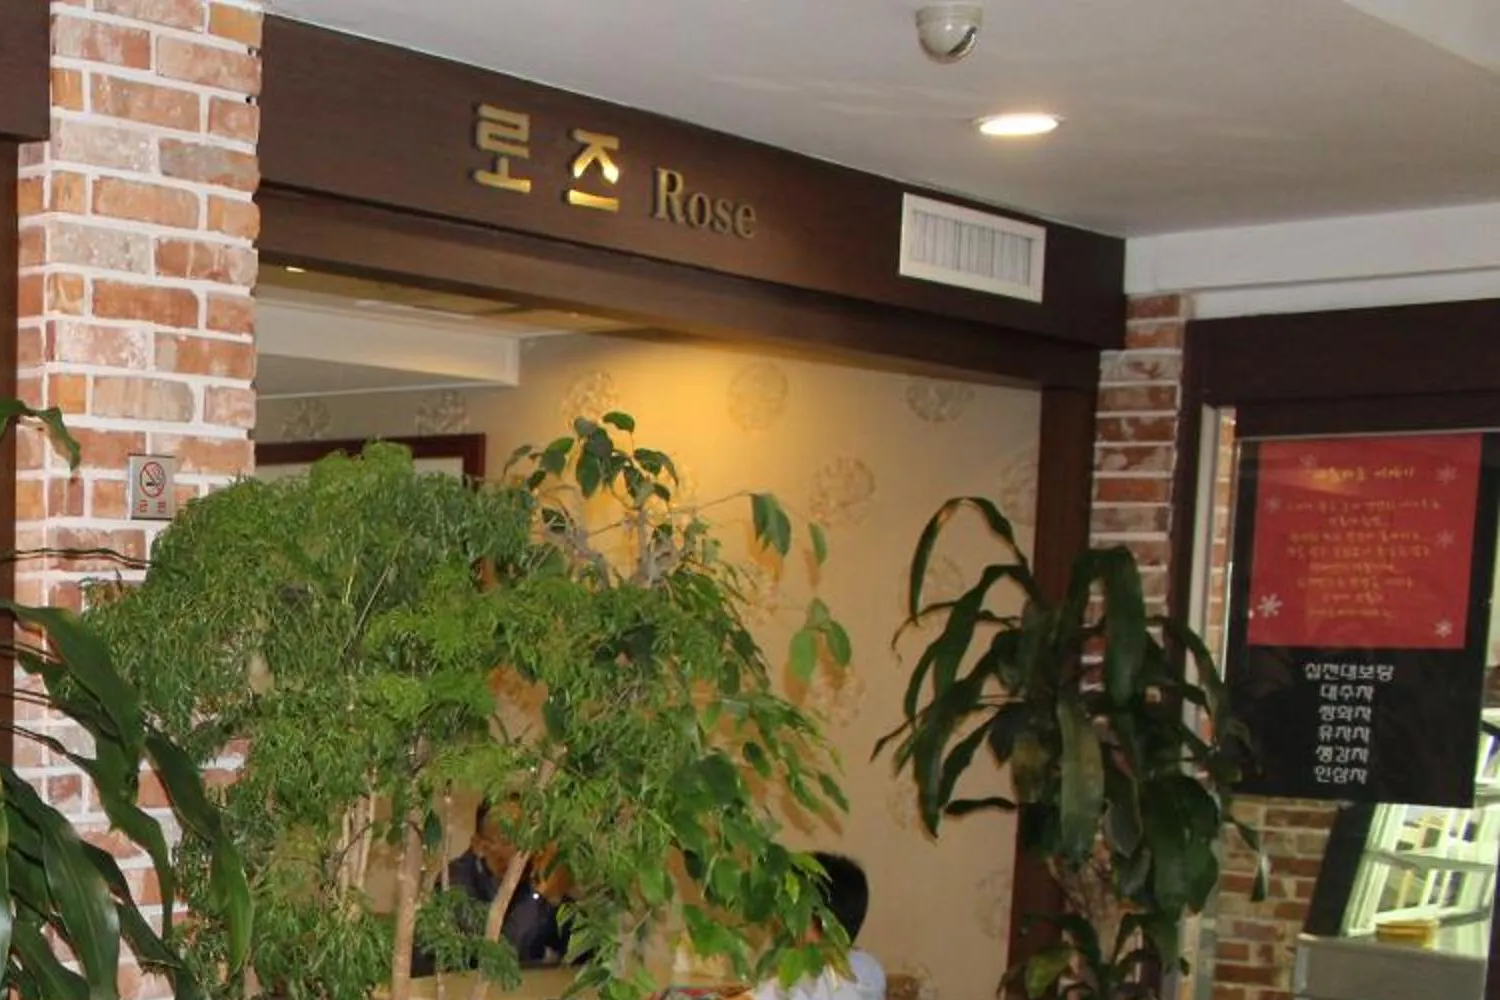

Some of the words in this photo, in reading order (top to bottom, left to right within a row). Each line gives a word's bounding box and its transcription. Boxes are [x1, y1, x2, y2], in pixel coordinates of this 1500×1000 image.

[473, 104, 620, 213] 로즈
[653, 166, 757, 239] Rose
[1318, 704, 1372, 722] 쌍화차
[1318, 725, 1371, 743] 유자차
[1315, 746, 1370, 763] 생강차
[1313, 766, 1367, 784] 인삼차
